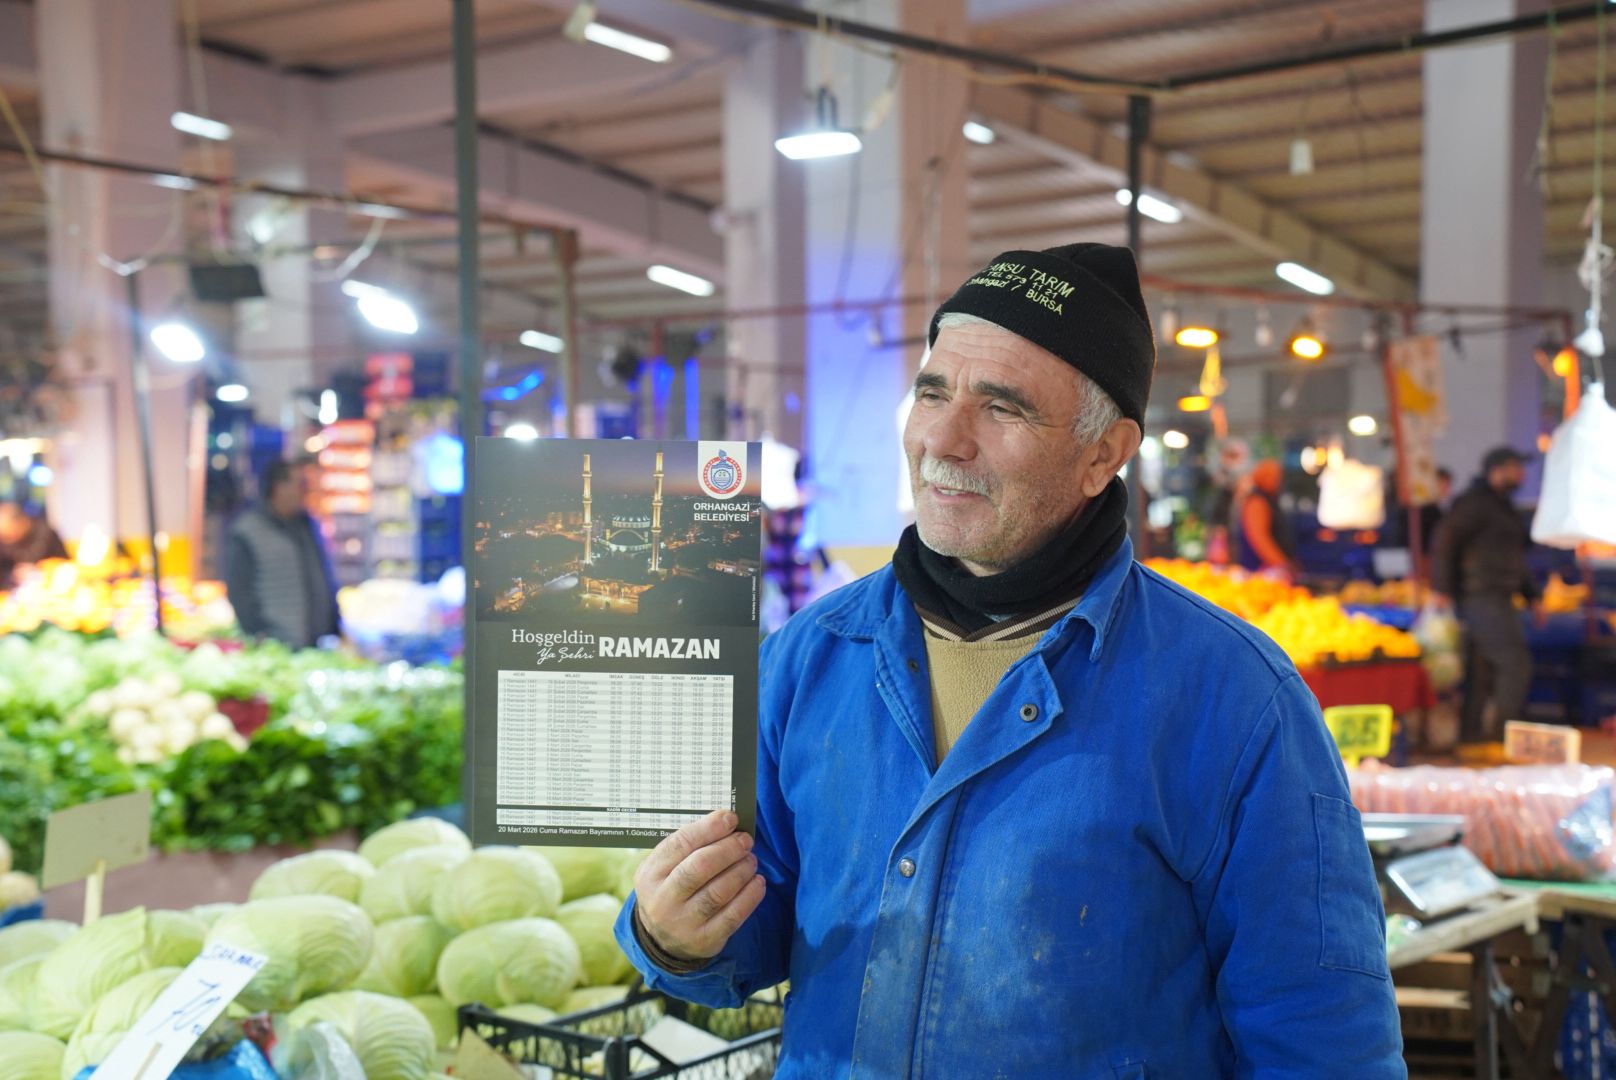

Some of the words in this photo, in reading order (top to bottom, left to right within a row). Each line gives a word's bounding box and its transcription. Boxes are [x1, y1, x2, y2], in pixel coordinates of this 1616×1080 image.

[982, 262, 1026, 274] ANSU
[1029, 268, 1075, 299] TARIM
[1032, 282, 1043, 291] 11
[1045, 288, 1058, 299] 21
[1026, 288, 1063, 316] BURSA
[693, 502, 750, 512] ORHANGAZİ
[693, 512, 750, 522] BELEDİYESİ
[511, 629, 595, 646] Hoşgeldin
[537, 647, 557, 665] Ya
[558, 646, 595, 663] Şehri
[599, 636, 720, 660] RAMAZAN
[522, 826, 538, 834] 2026
[559, 827, 588, 835] Ramazan
[589, 828, 624, 836] Bayramının
